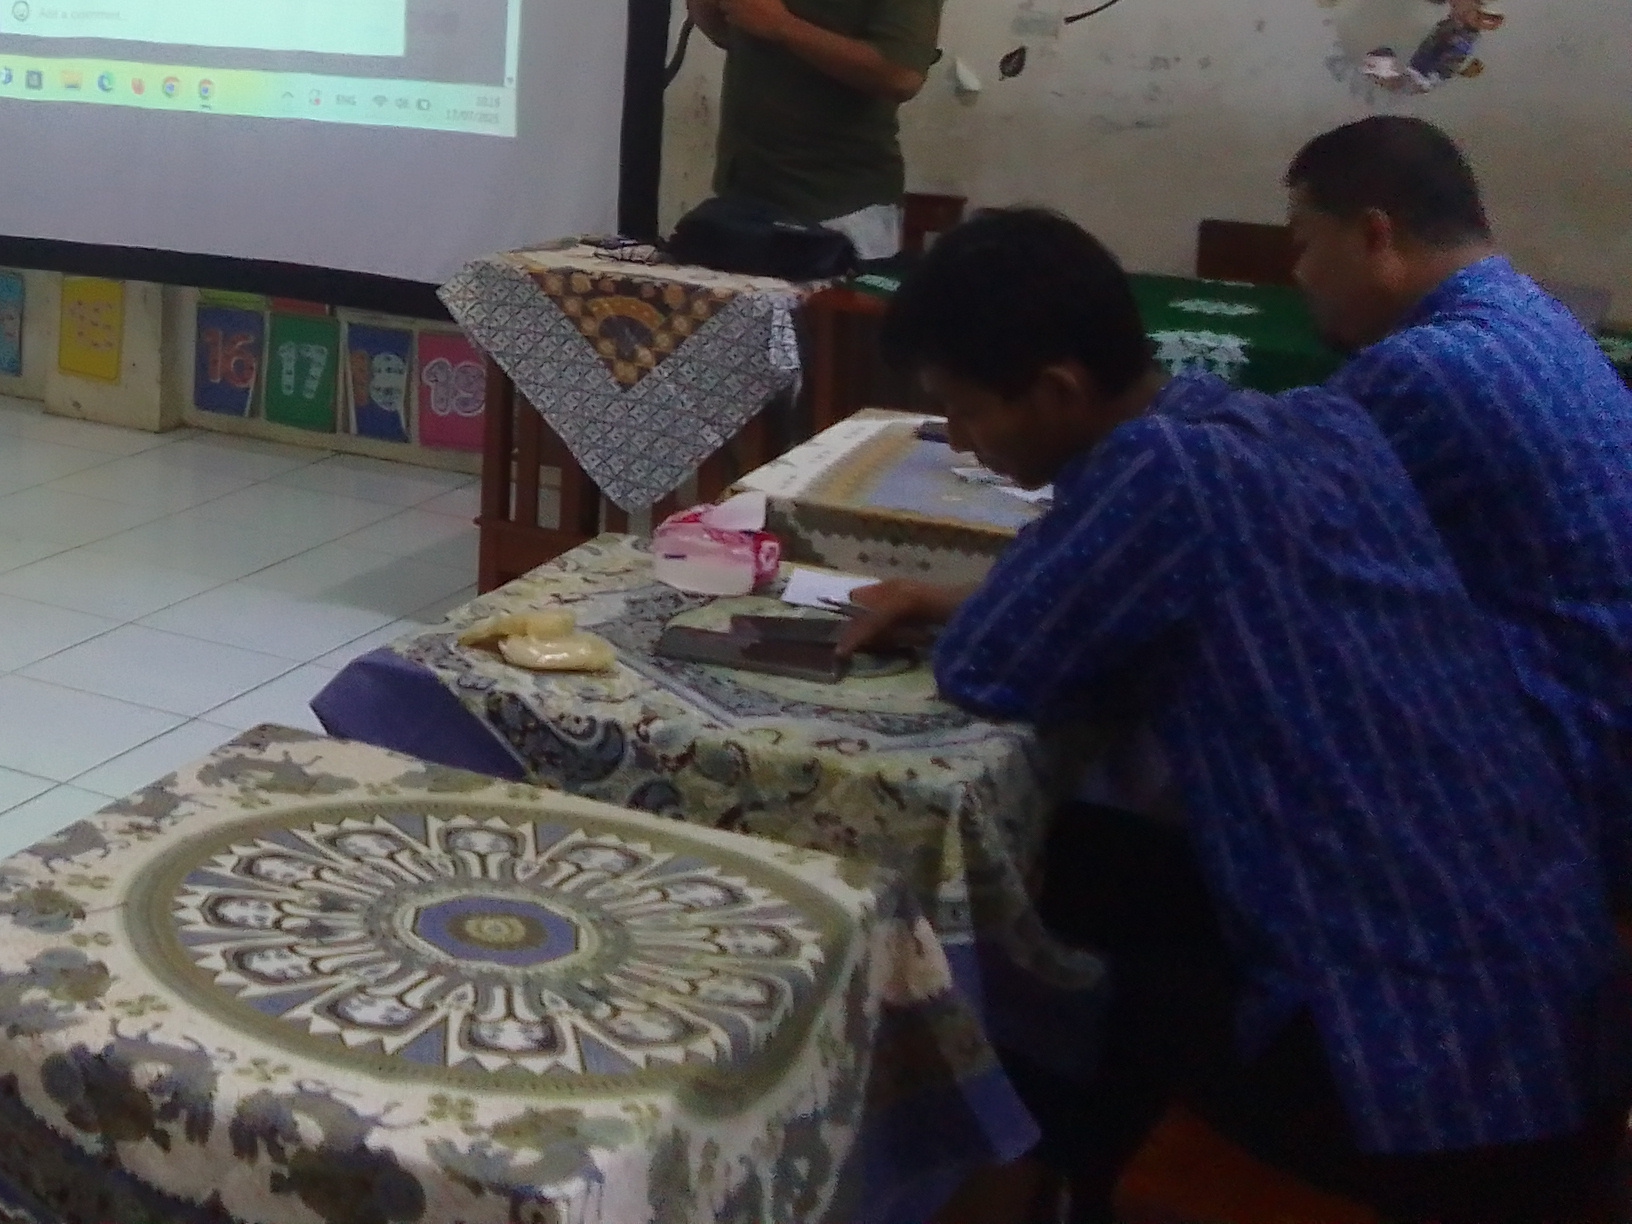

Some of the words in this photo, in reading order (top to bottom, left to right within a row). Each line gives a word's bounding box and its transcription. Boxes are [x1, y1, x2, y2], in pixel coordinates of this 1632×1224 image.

[204, 328, 256, 389] 16
[277, 341, 328, 400] 17
[422, 357, 486, 418] 19
